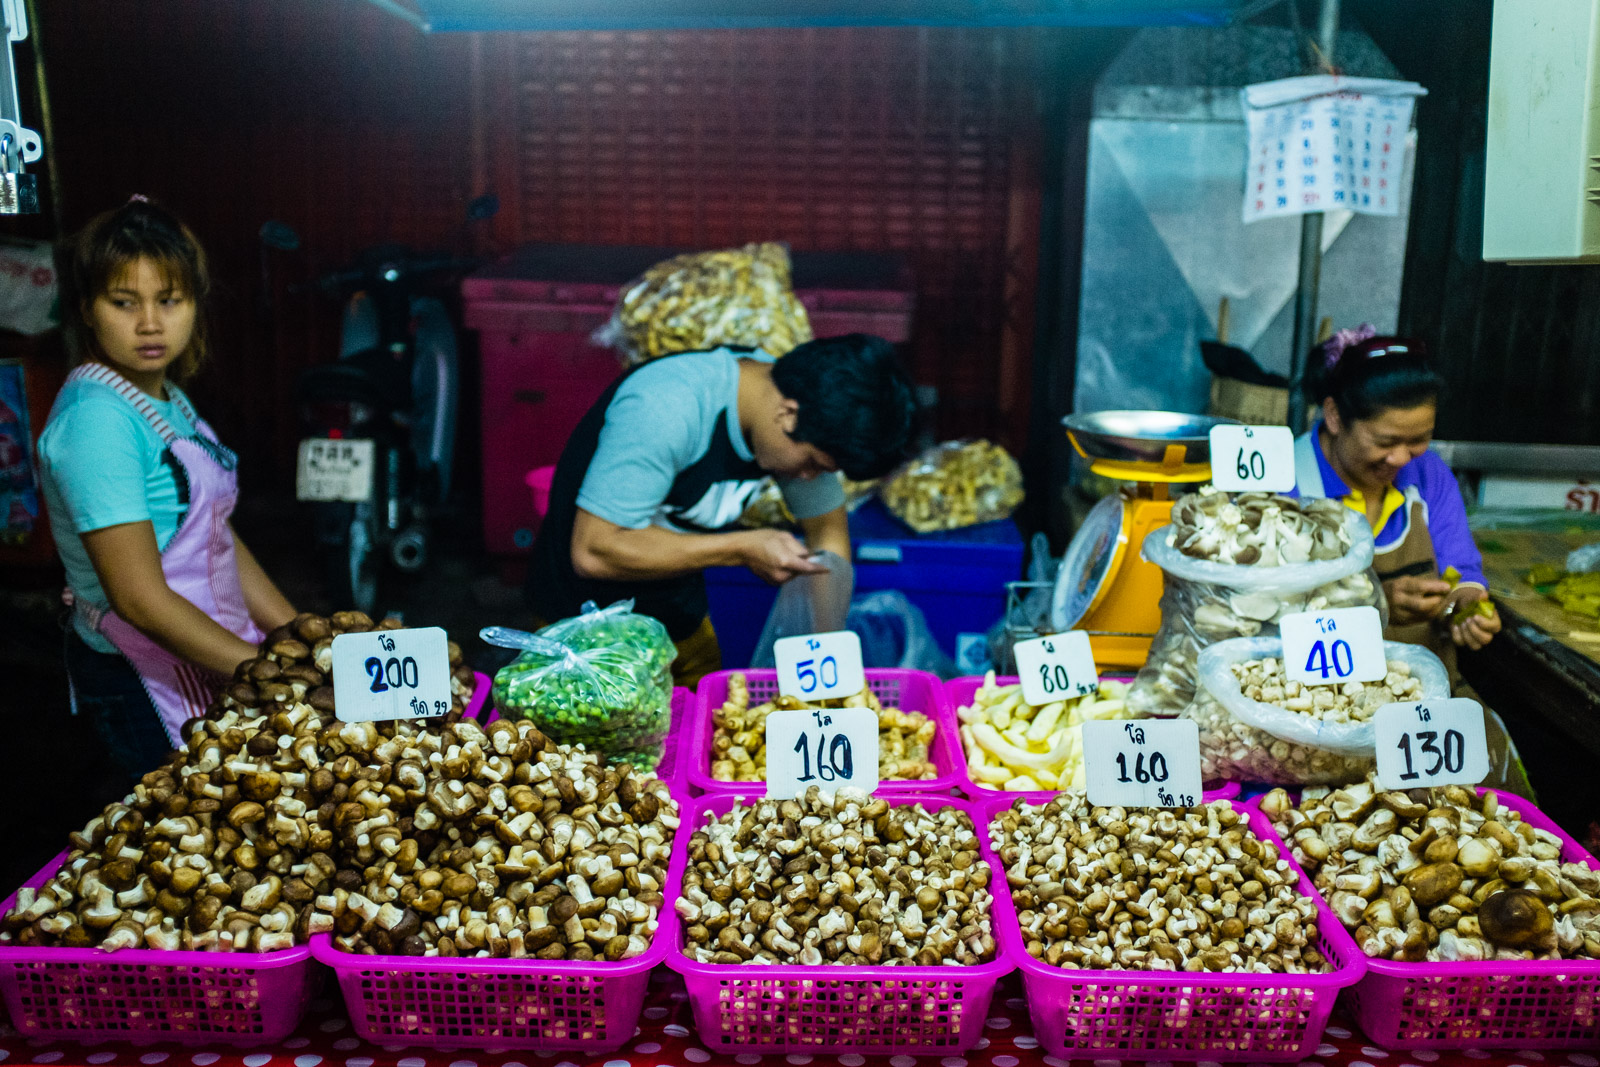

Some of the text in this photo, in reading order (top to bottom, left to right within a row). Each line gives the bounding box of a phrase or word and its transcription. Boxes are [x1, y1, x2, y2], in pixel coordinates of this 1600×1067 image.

[1237, 447, 1265, 480] 60
[378, 634, 396, 651] โล
[1305, 639, 1354, 679] 40
[365, 656, 419, 693] 200
[796, 656, 838, 693] 50
[1040, 664, 1069, 693] 80
[1125, 723, 1145, 744] โล
[794, 731, 853, 782] 160
[1116, 751, 1169, 783] 160
[1397, 729, 1465, 780] 130
[1180, 793, 1194, 808] 18
